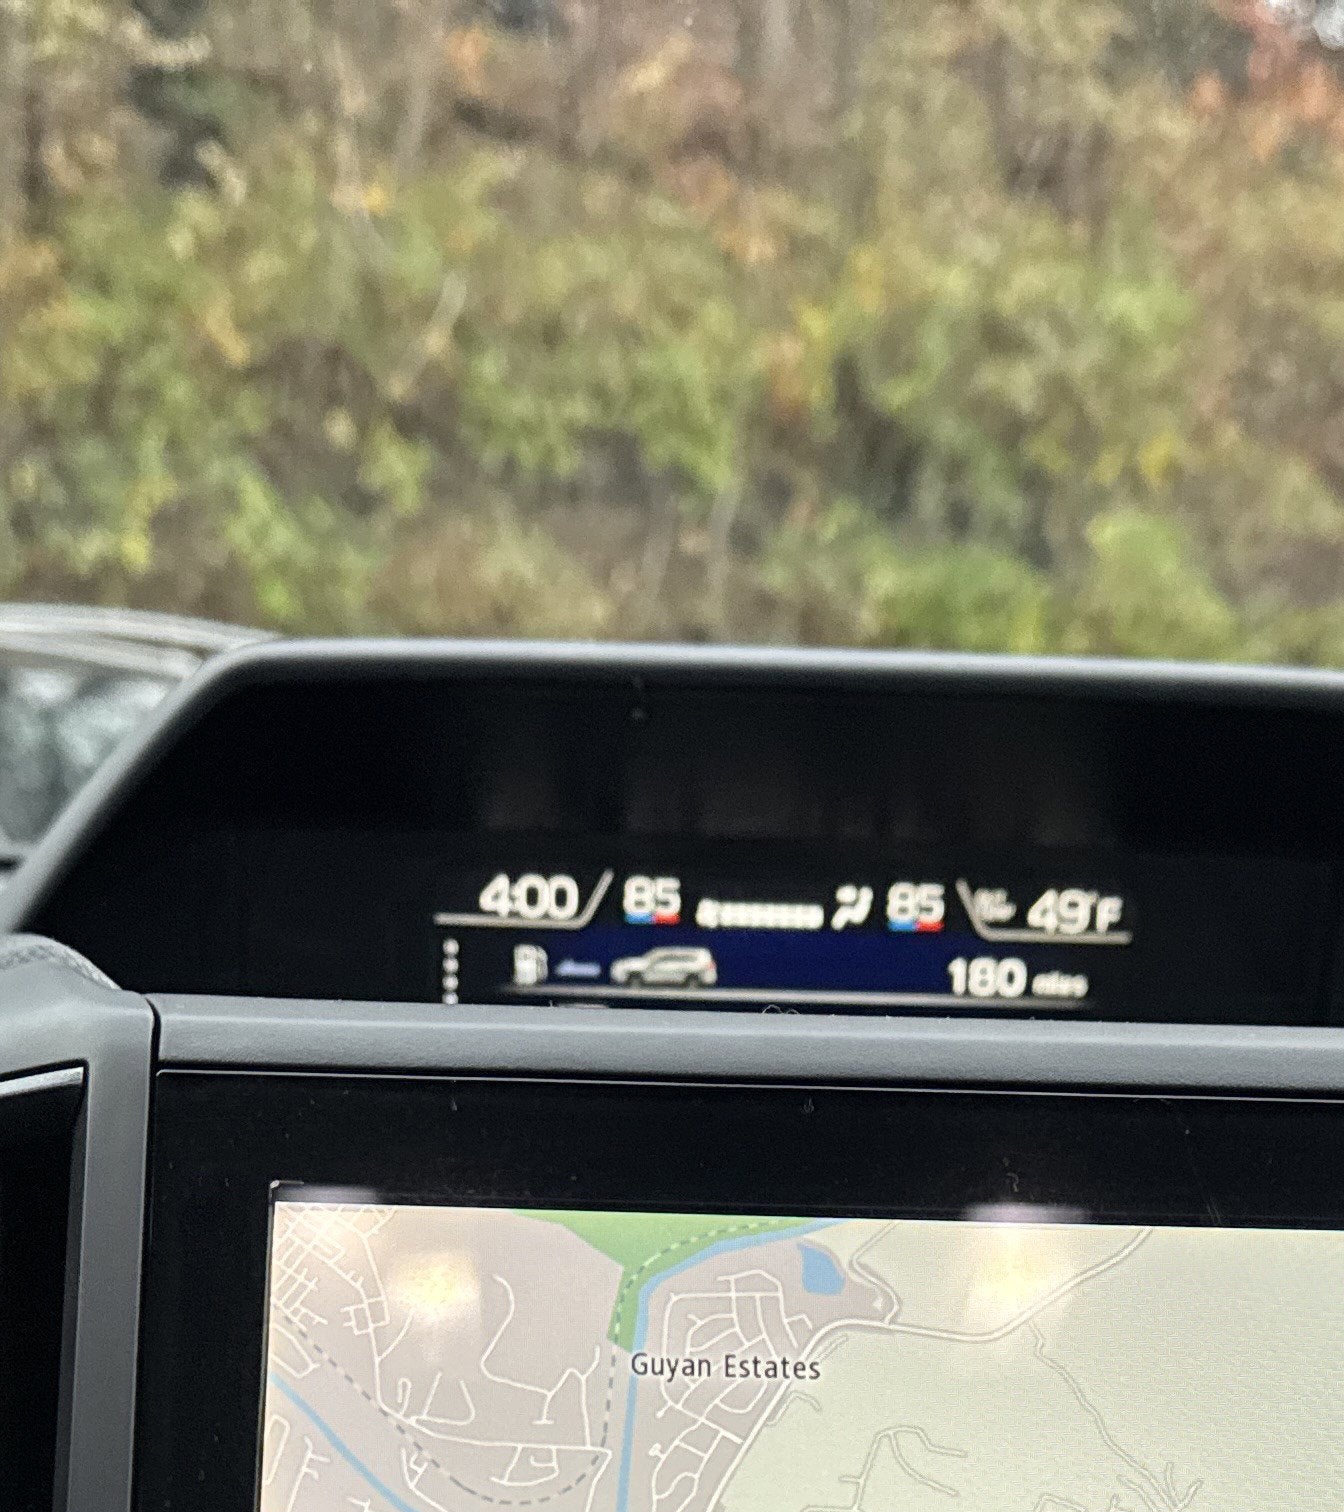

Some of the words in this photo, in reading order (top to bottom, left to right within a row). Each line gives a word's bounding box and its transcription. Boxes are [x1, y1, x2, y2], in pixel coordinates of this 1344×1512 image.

[479, 873, 579, 920] 400
[623, 873, 682, 914] 85
[887, 881, 945, 921] 85
[947, 956, 1028, 997] 180
[631, 1353, 711, 1382] Guyan
[725, 1354, 821, 1380] Estates
